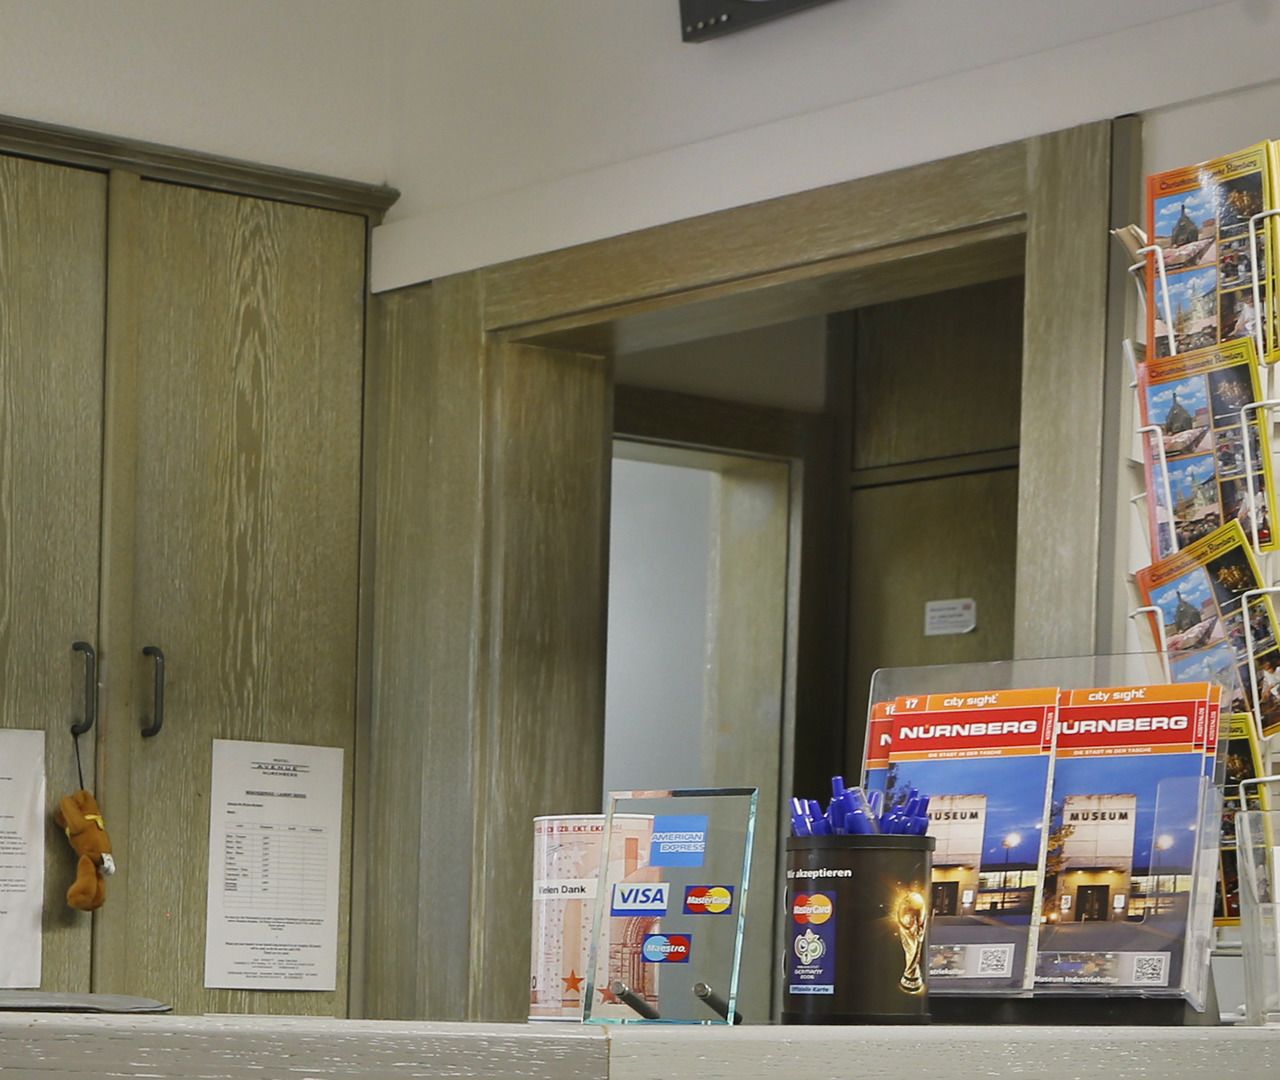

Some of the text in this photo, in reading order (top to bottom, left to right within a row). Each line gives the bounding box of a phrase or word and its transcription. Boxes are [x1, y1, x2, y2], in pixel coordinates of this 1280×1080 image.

[1088, 690, 1144, 702] city sight
[905, 698, 918, 709] 17
[943, 695, 997, 708] city sight
[1069, 811, 1129, 821] MUSEUM
[652, 833, 703, 841] AMERICAN
[661, 843, 705, 851] EXPRESS
[561, 885, 586, 894] Dank
[620, 888, 664, 904] VISA
